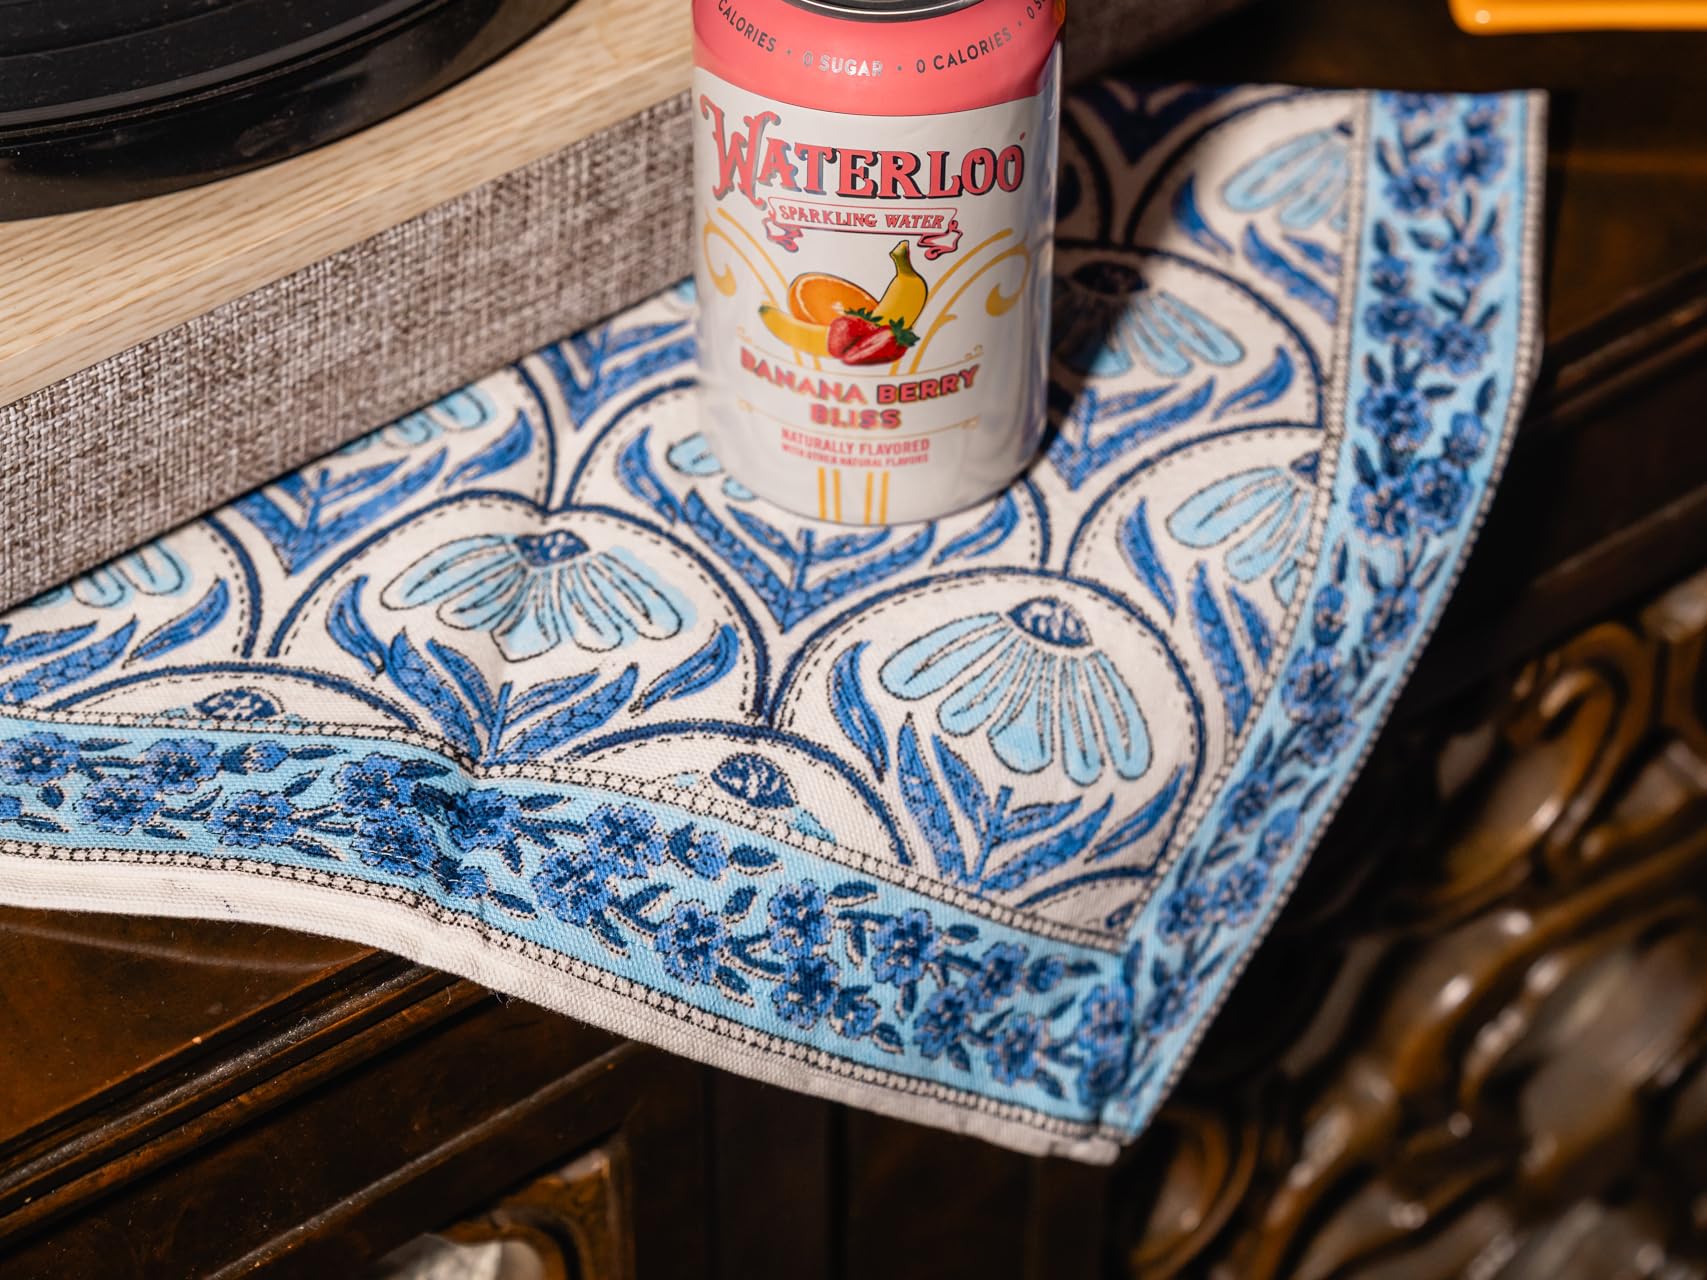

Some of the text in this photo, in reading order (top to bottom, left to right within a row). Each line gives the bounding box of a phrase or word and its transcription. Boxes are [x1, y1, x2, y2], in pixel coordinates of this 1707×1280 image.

[819, 54, 884, 78] SUGAR
[933, 26, 1013, 71] CALORIES
[701, 95, 1025, 210] WATERLOO
[778, 204, 945, 229] SPARKLING WATER
[740, 346, 980, 405] BANANA BERRY
[810, 403, 902, 430] BLISS
[781, 427, 930, 456] NATURALLY FLAVORED
